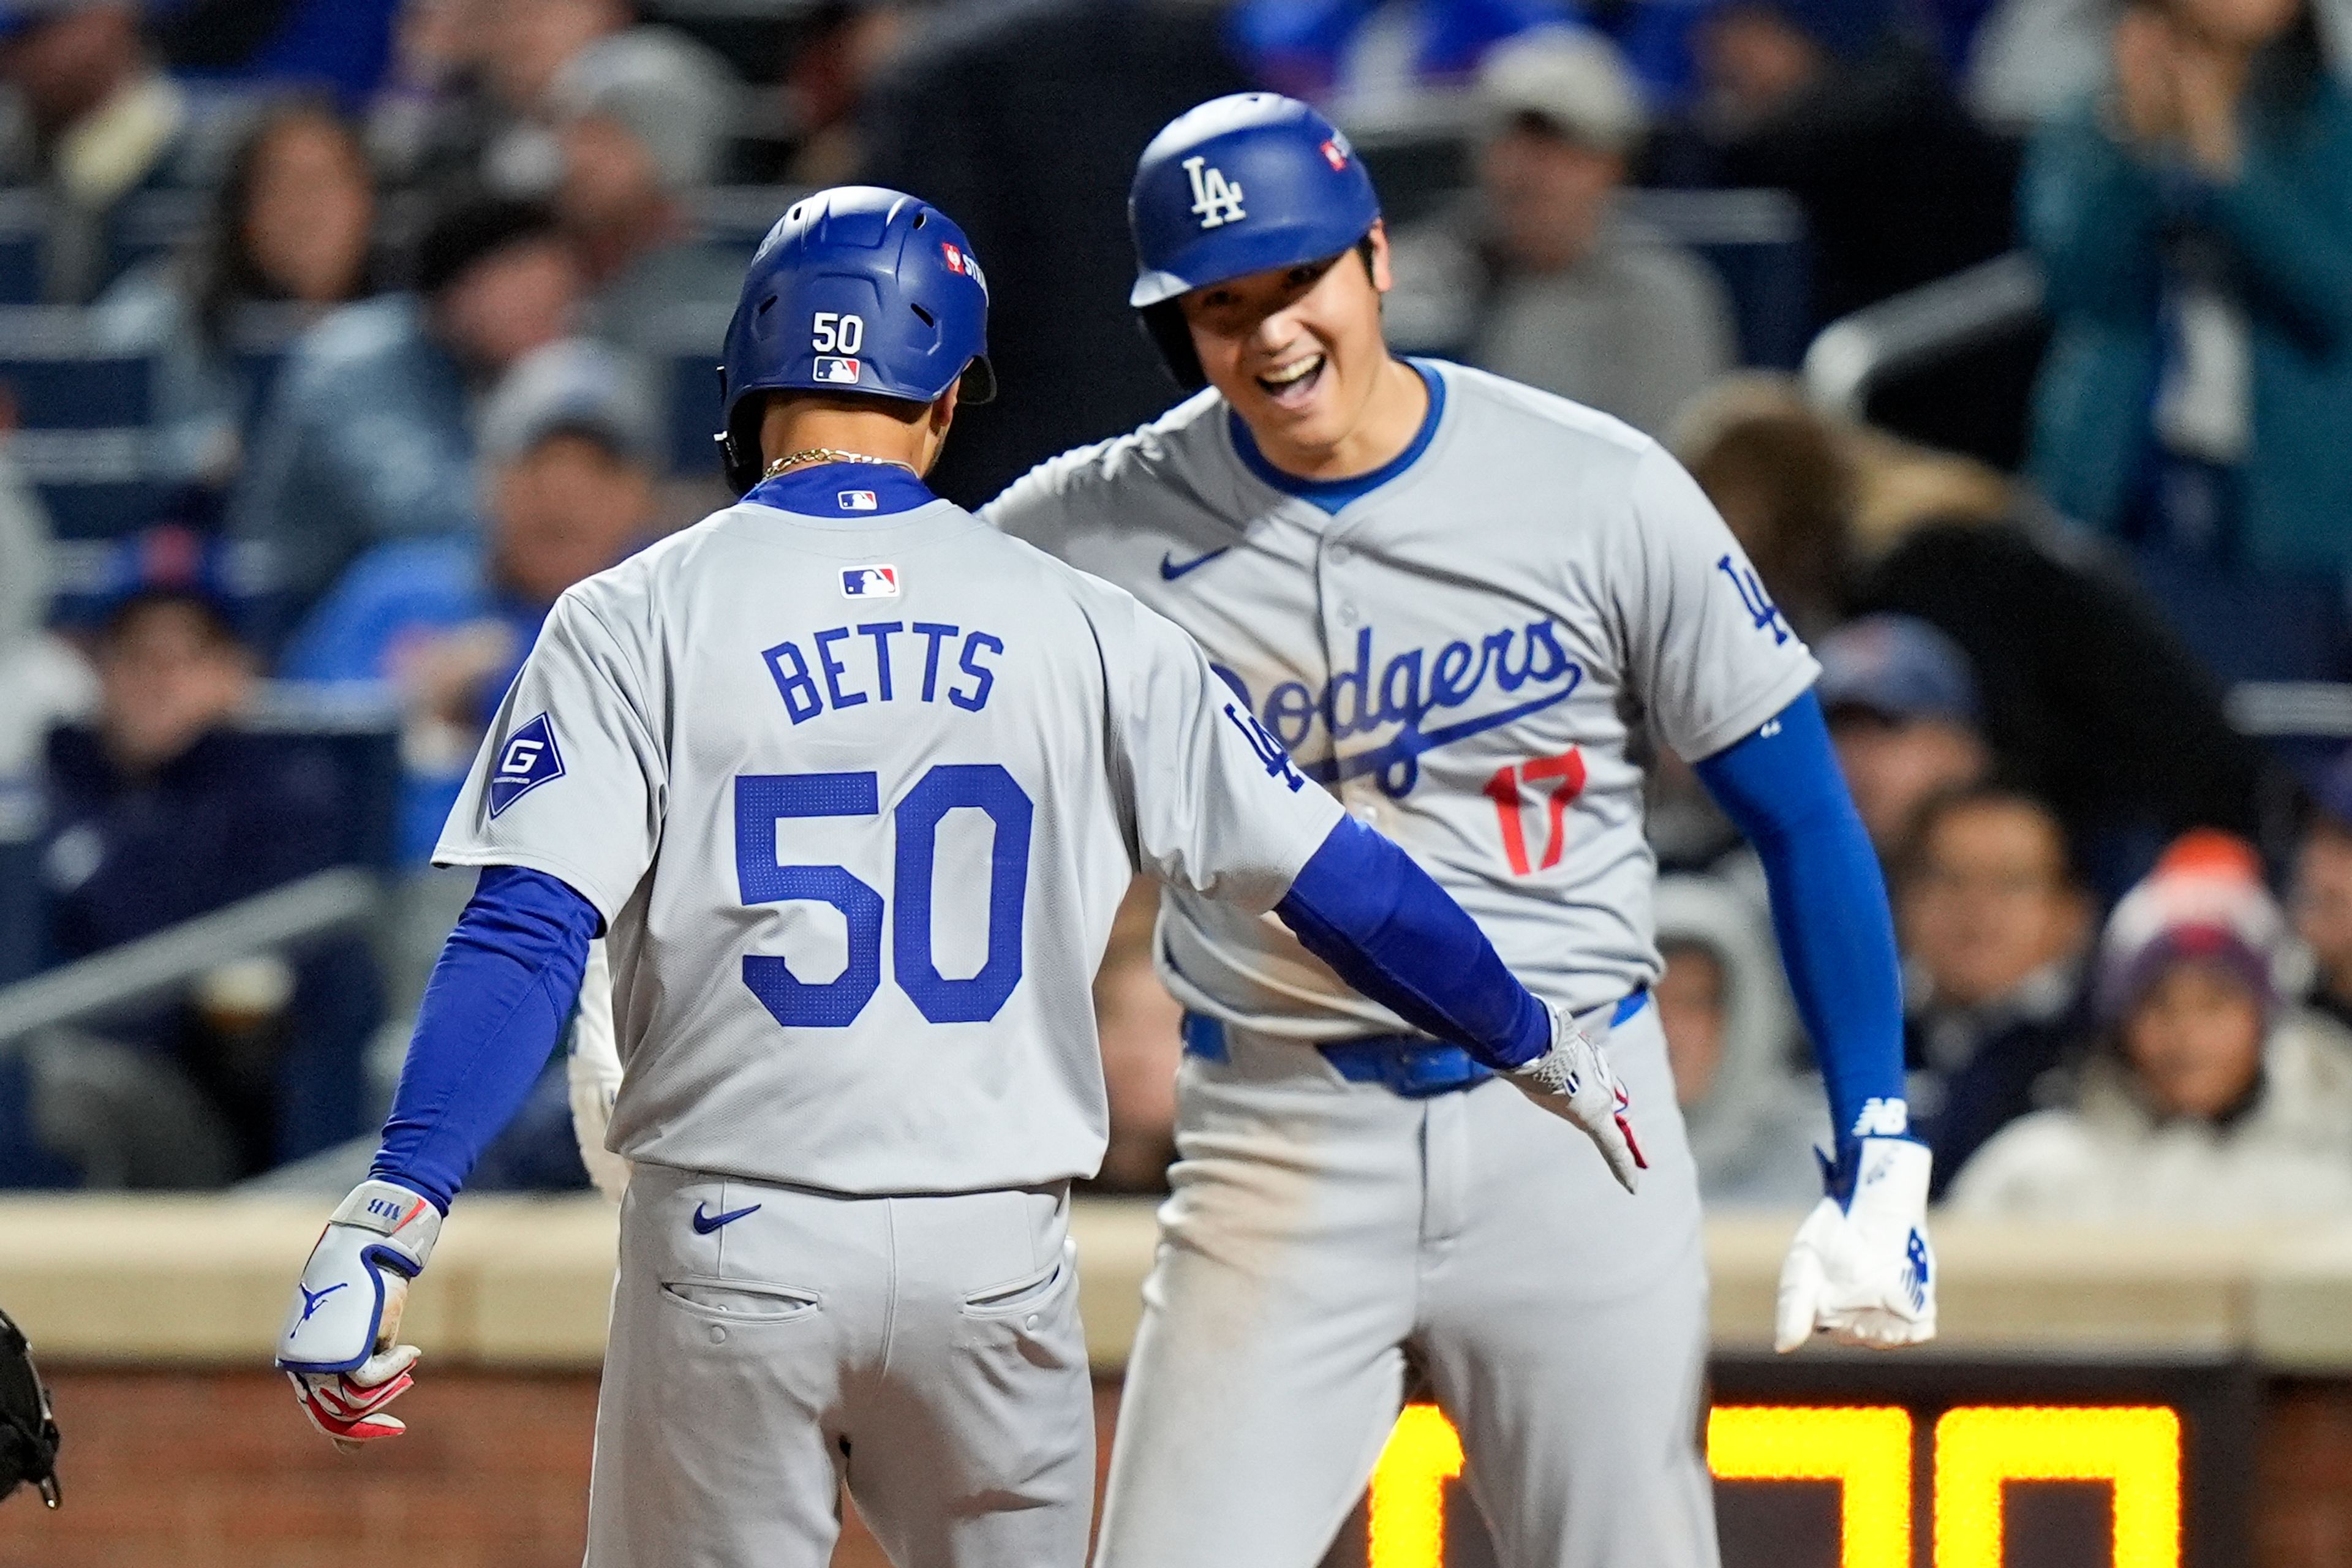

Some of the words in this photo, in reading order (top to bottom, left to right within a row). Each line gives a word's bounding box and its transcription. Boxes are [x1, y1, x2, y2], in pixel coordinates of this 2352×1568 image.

[1182, 156, 1246, 229] LA
[812, 312, 863, 355] 50
[761, 621, 1005, 725] BETTS
[502, 739, 544, 773] G
[1482, 745, 1586, 875] 17
[735, 764, 1034, 1028] 50
